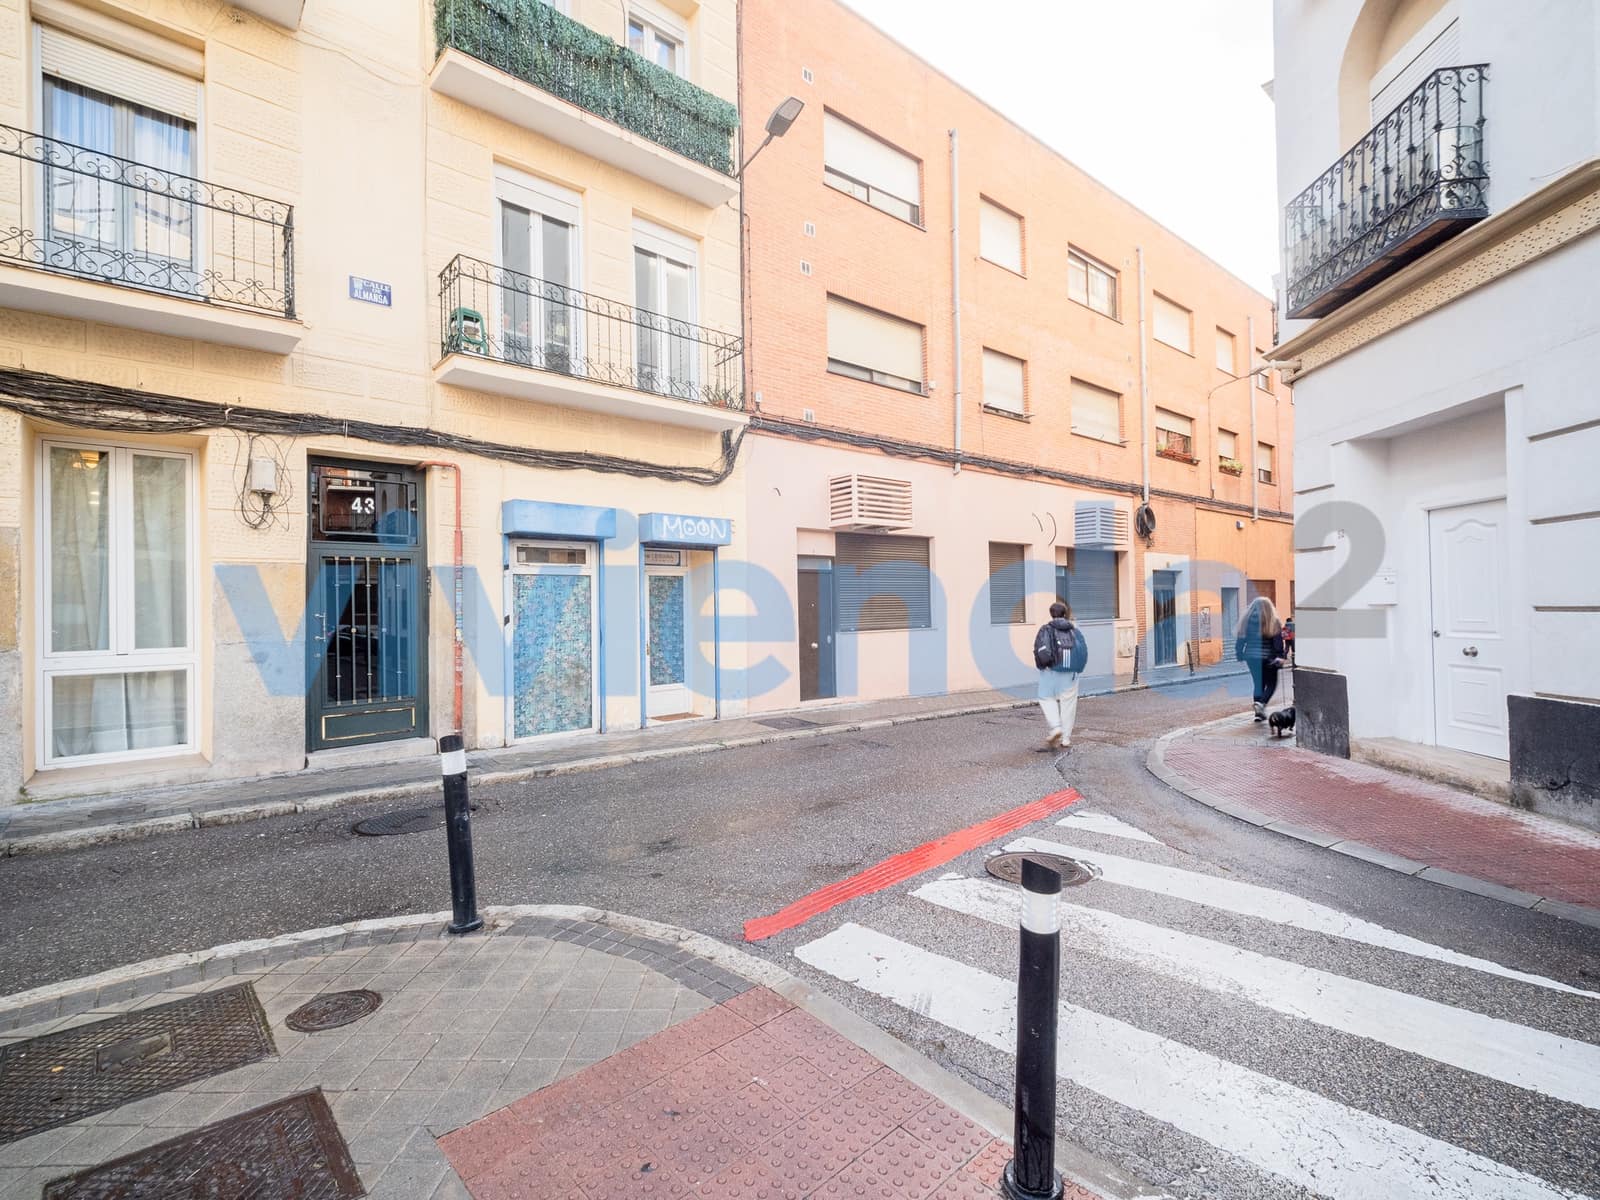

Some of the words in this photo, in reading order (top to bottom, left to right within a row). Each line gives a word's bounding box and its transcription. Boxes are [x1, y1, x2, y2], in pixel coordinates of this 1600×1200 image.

[363, 280, 391, 292] CALLE
[353, 287, 389, 304] ALMANSA
[351, 497, 375, 514] 43
[660, 515, 727, 540] MOON
